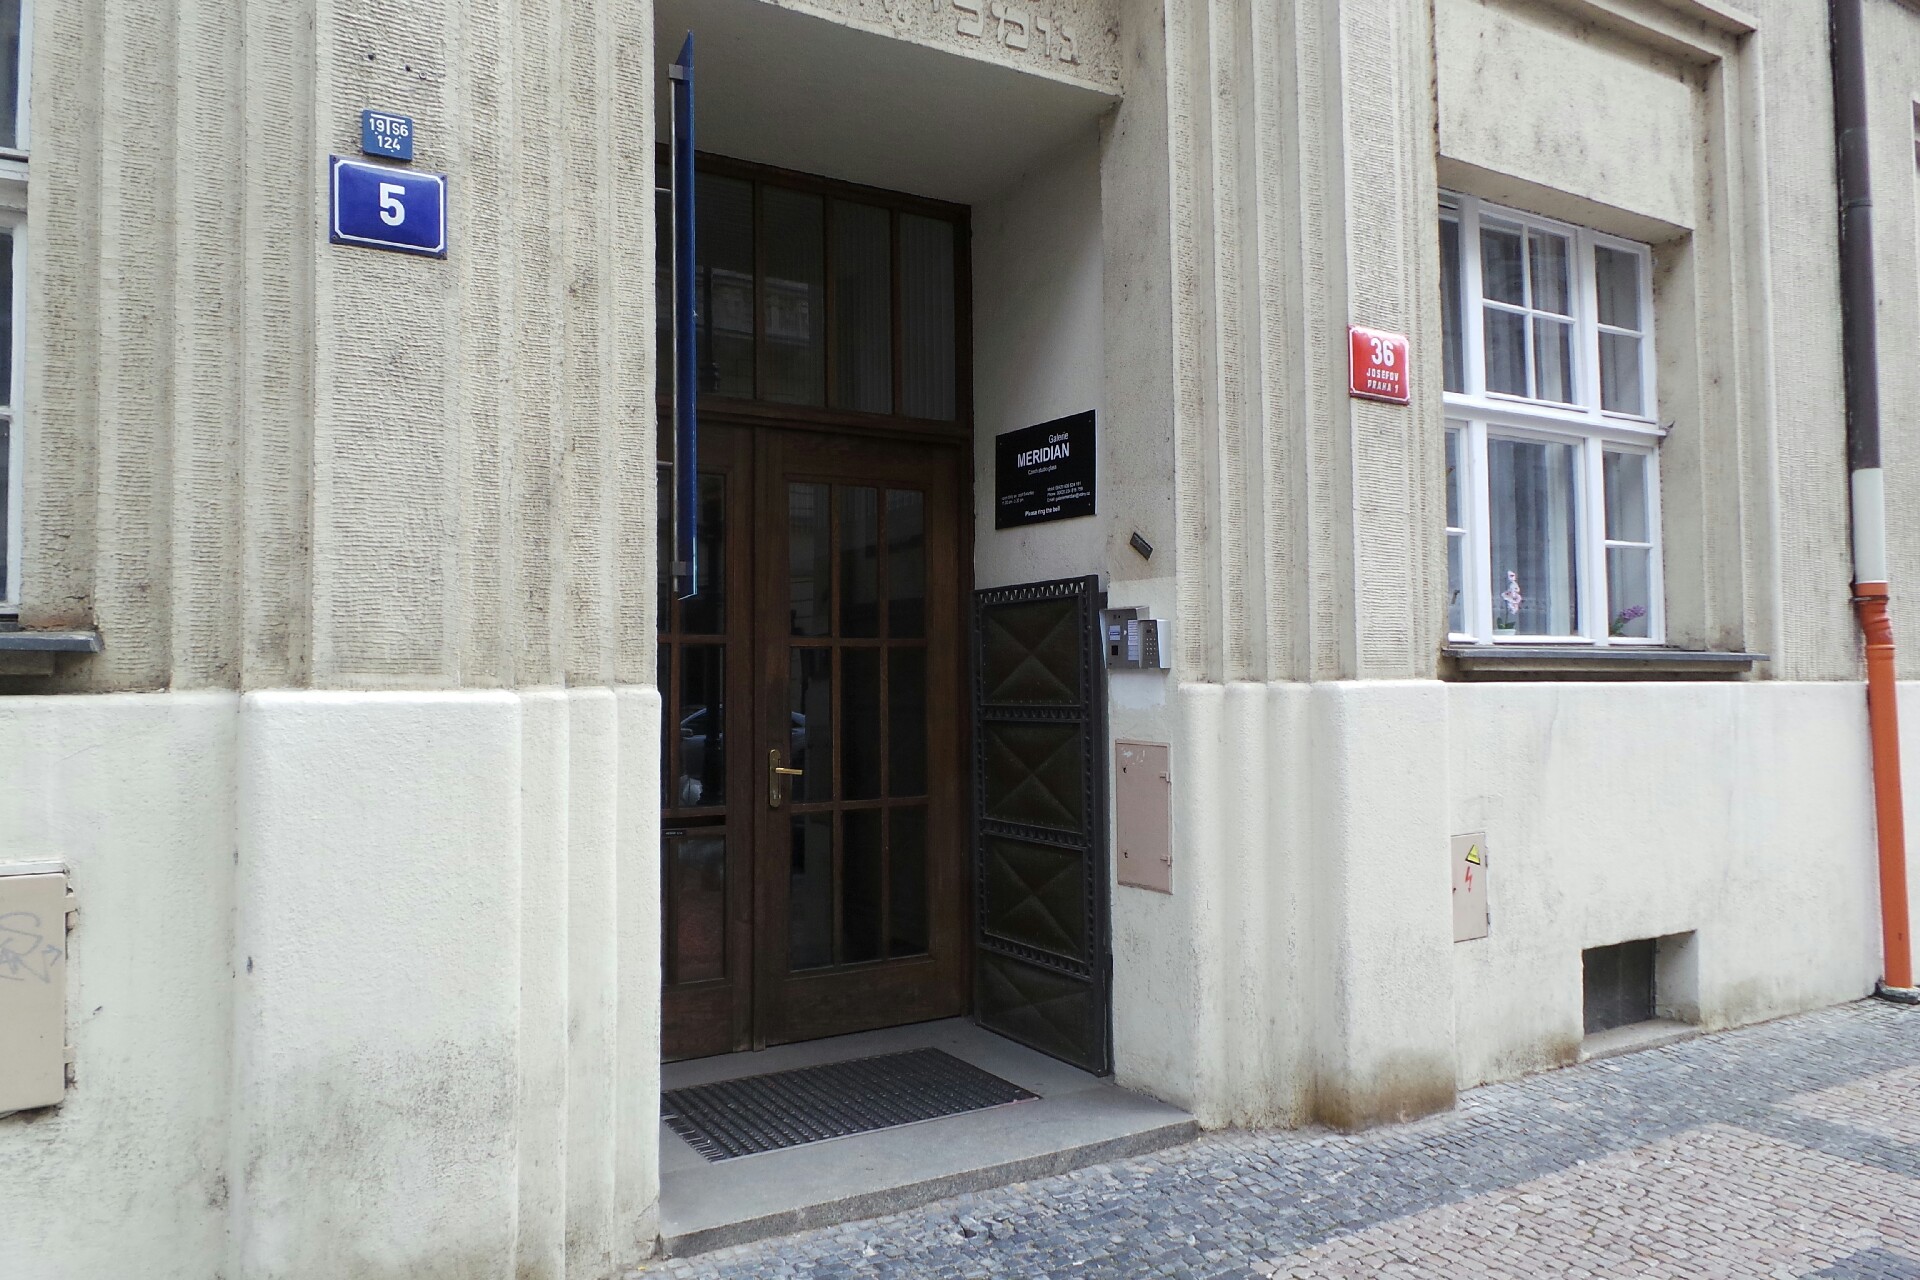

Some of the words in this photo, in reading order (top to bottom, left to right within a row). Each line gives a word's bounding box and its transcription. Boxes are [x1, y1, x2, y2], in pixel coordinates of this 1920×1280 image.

[377, 135, 401, 150] 124
[379, 182, 406, 227] 5
[1370, 337, 1395, 367] 36
[1366, 367, 1399, 382] JOSEFOV
[1367, 379, 1392, 392] PRAHA
[1394, 384, 1399, 394] 1
[1048, 431, 1069, 444] Galerie
[1017, 442, 1070, 468] MERIDIAN
[1037, 508, 1046, 516] ring
[1052, 505, 1061, 513] bell
